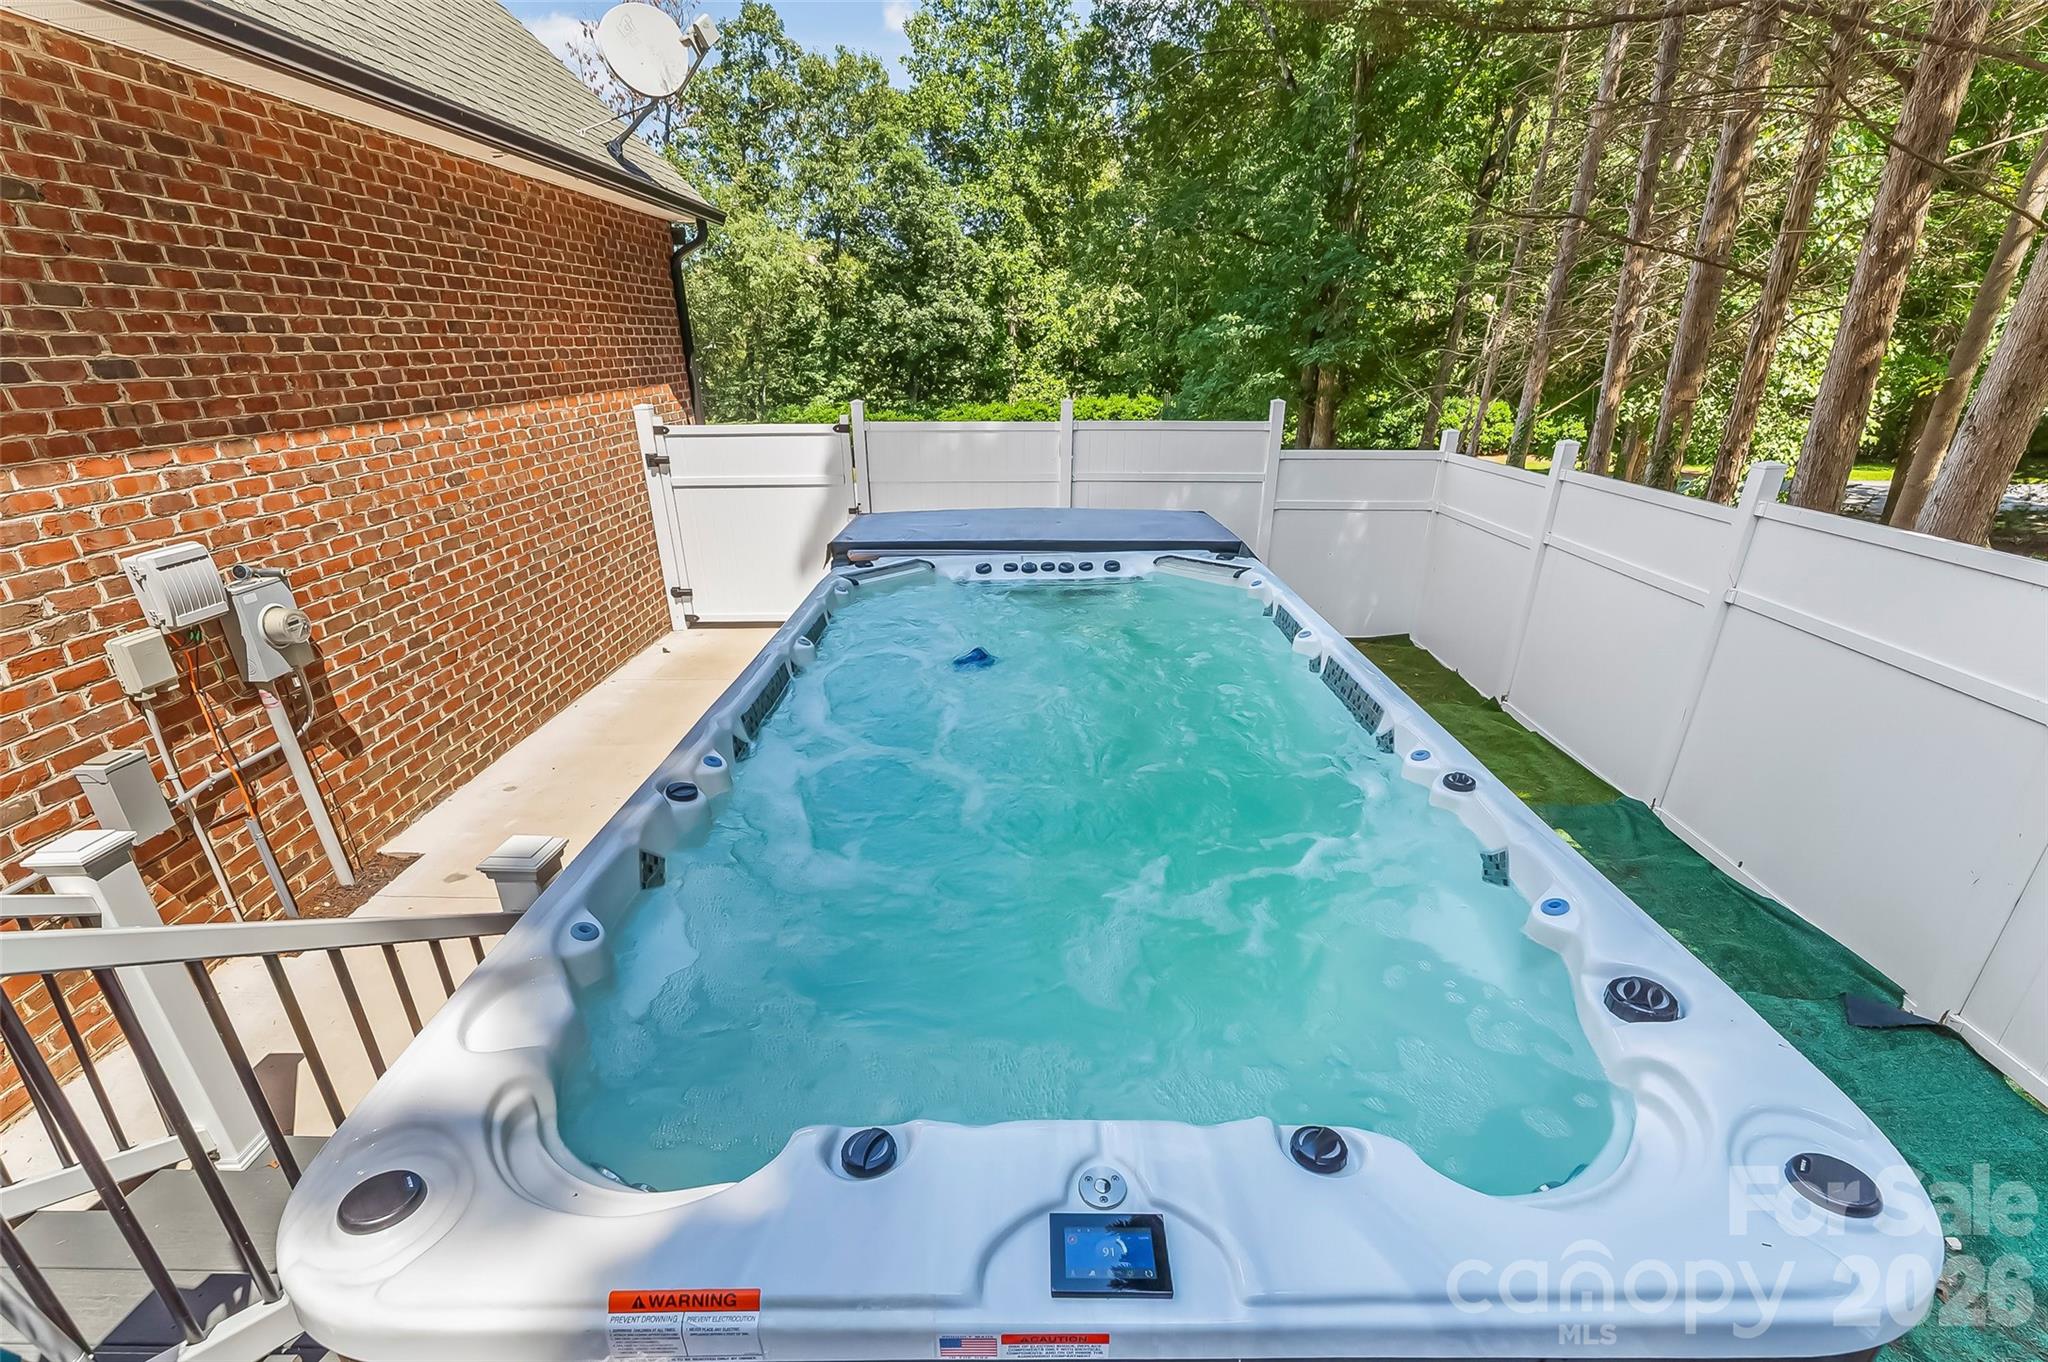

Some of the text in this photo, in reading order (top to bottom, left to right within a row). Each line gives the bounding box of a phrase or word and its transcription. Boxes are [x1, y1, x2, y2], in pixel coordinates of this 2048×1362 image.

[1102, 1247, 1115, 1257] 91
[648, 1293, 737, 1308] WARNING
[610, 1314, 678, 1324] PREVENT DROWNING
[686, 1314, 757, 1323] PREVENT ELECTROCUTION
[1030, 1335, 1088, 1343] CAUTION
